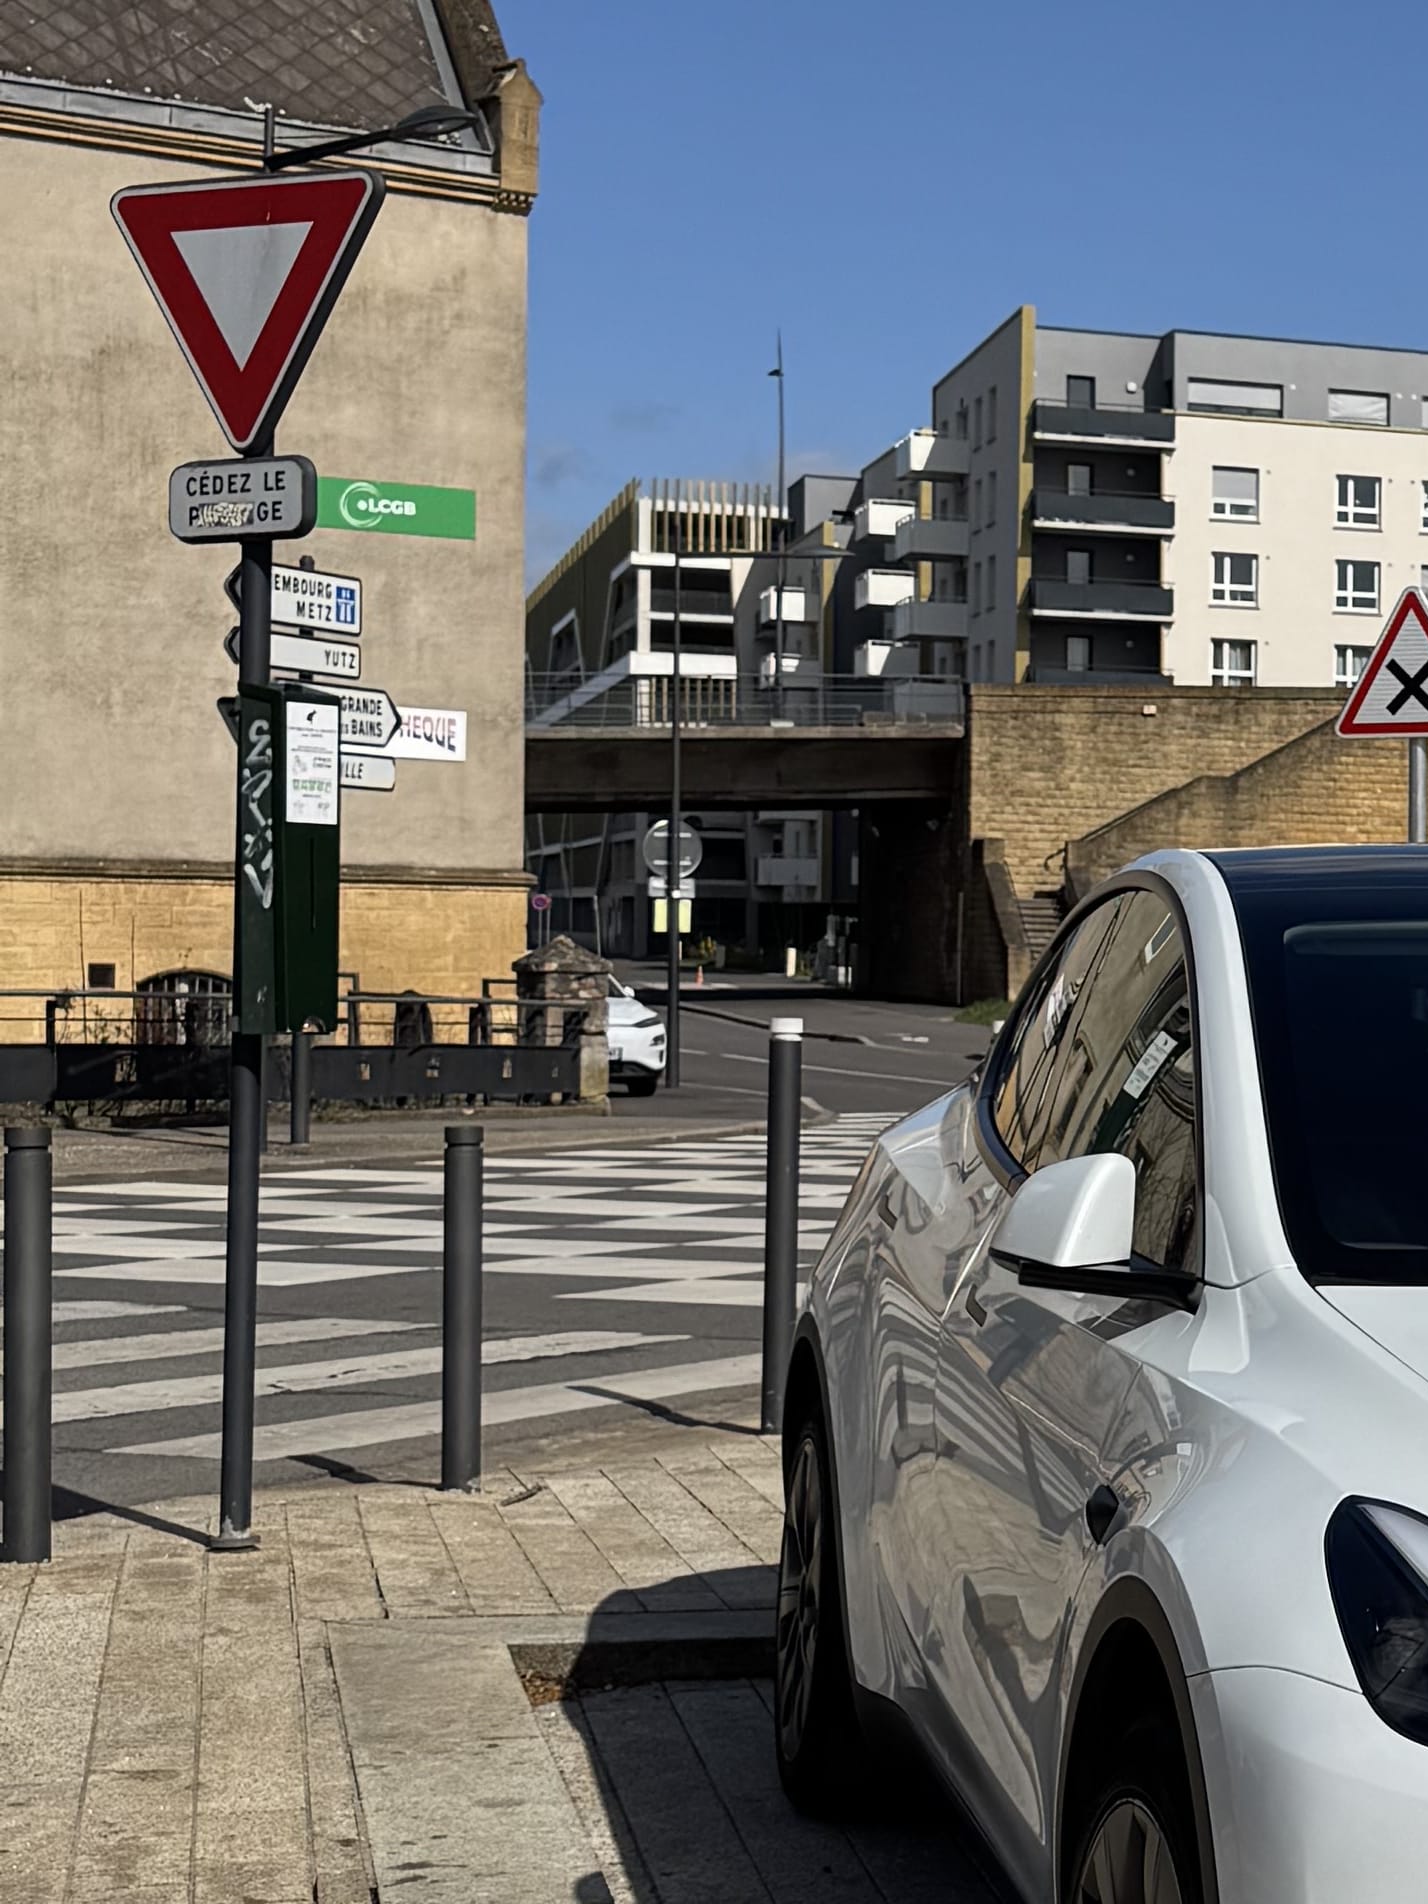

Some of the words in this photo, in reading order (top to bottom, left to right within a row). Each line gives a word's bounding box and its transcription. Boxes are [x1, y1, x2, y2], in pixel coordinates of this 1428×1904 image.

[186, 470, 251, 497] CÉDEZ
[264, 470, 286, 492] LE
[367, 498, 417, 516] LCGB
[274, 574, 332, 599] EMBOURG
[296, 601, 332, 622] METZ
[324, 649, 356, 669] YUTZ
[340, 695, 383, 716] GRANDE
[351, 718, 383, 737] BAINS
[398, 714, 457, 753] HEQUE
